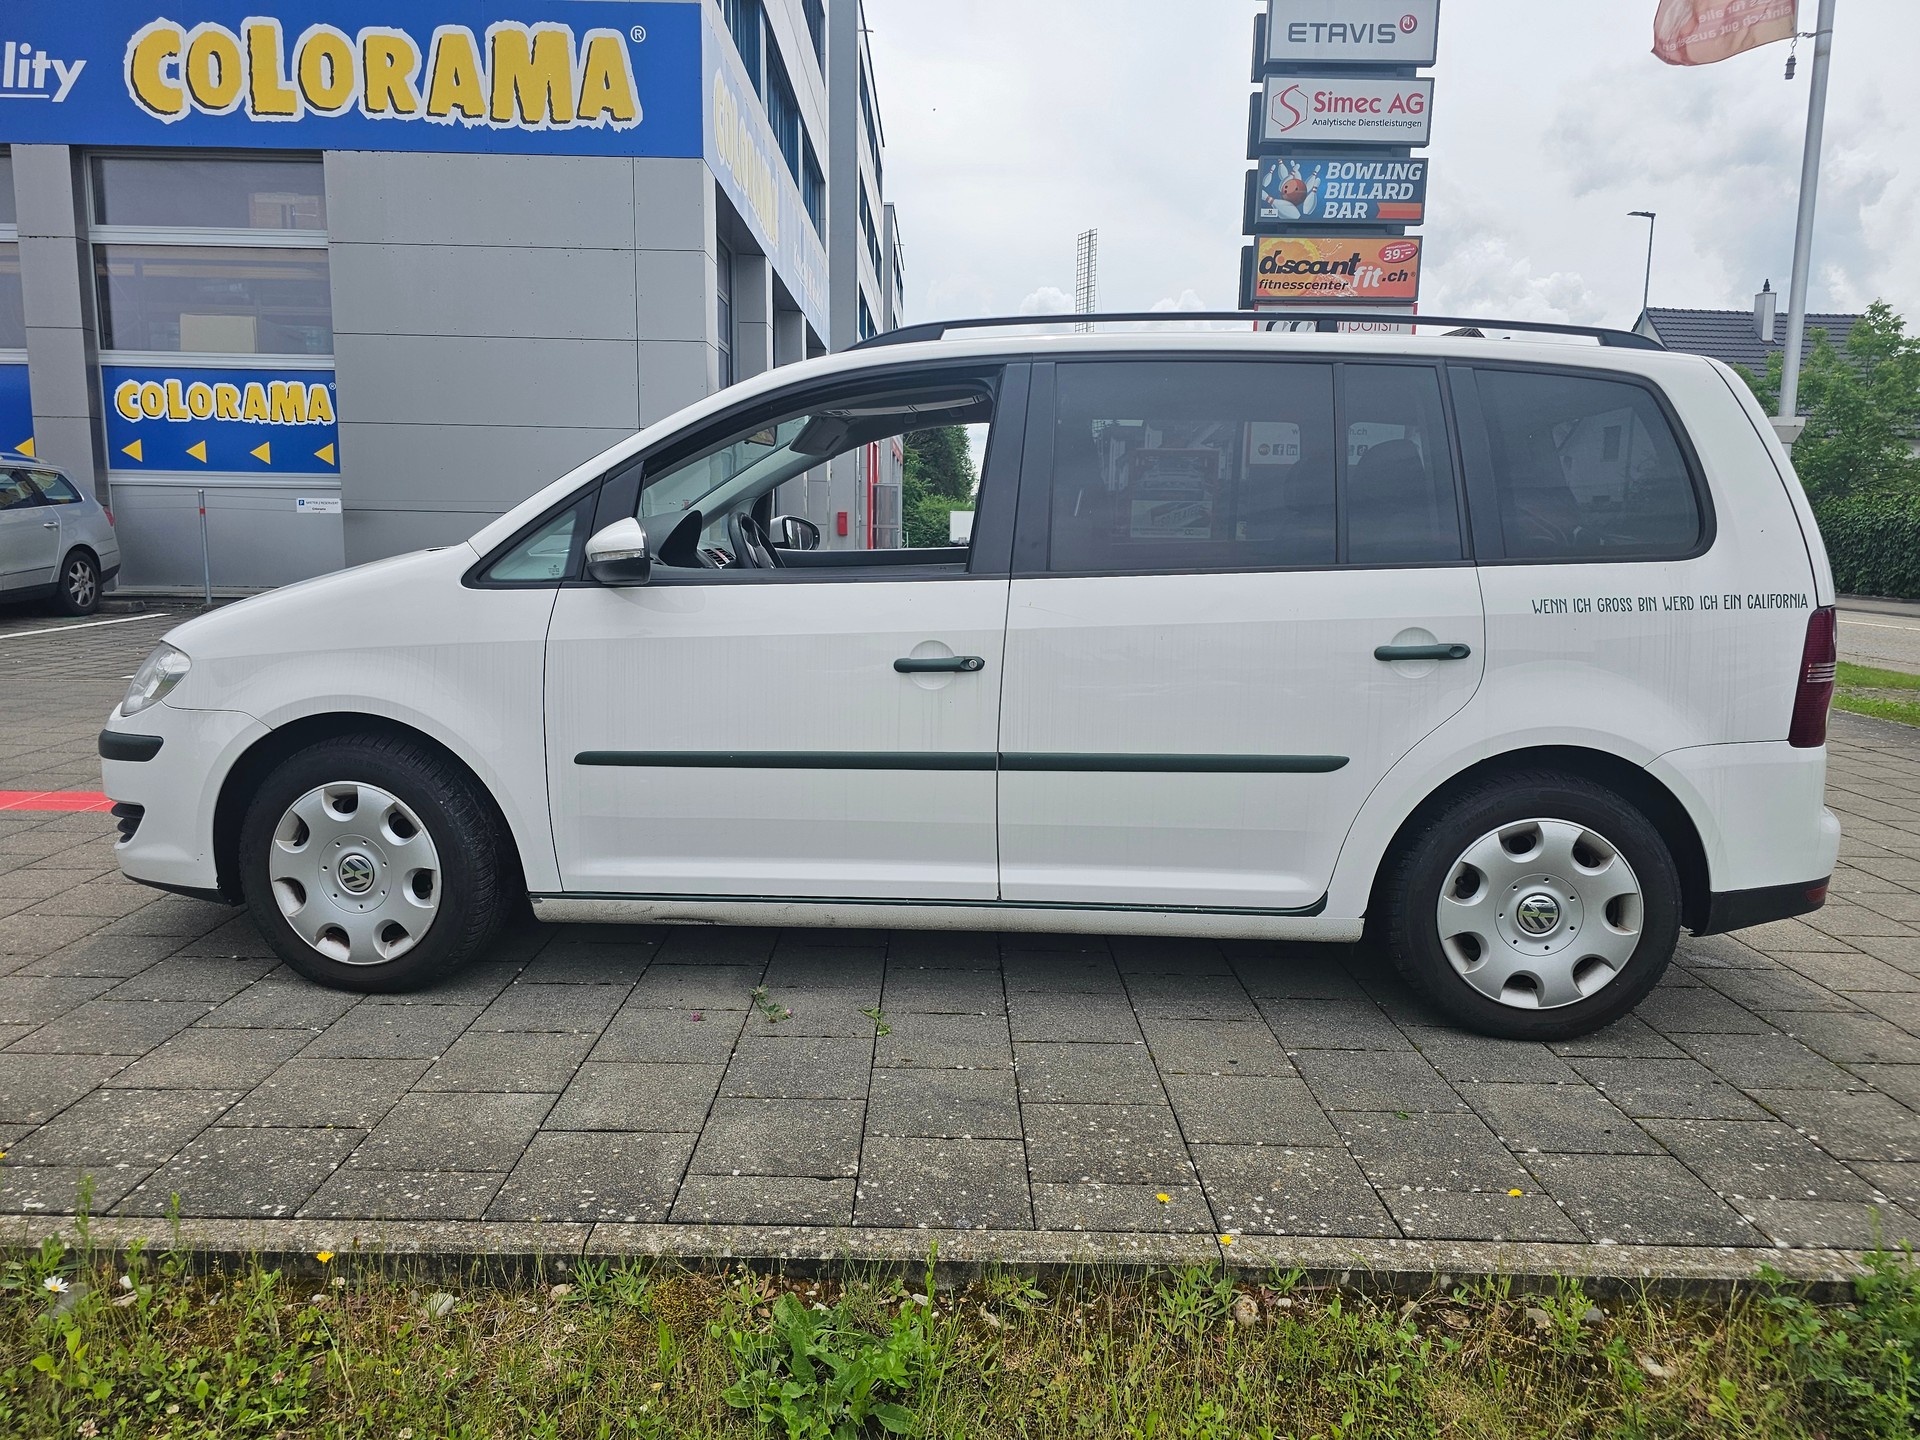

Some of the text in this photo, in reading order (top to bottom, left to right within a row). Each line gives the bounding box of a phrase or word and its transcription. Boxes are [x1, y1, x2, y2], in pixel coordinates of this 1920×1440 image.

[1288, 23, 1396, 43] ETAVIS
[125, 17, 642, 131] COLORAMA
[1313, 91, 1424, 114] Simec AG
[1312, 118, 1422, 128] Analytische Dienstleistungen
[1325, 162, 1423, 180] BOWLING
[1324, 183, 1413, 200] BILLARD
[1323, 202, 1368, 219] BAR
[1258, 279, 1348, 290] fitnesscenter
[115, 379, 336, 425] COLORAMA
[1532, 593, 1809, 614] WENN ICH GROSS BIN WERD ICH EIN CALIFORNIA
